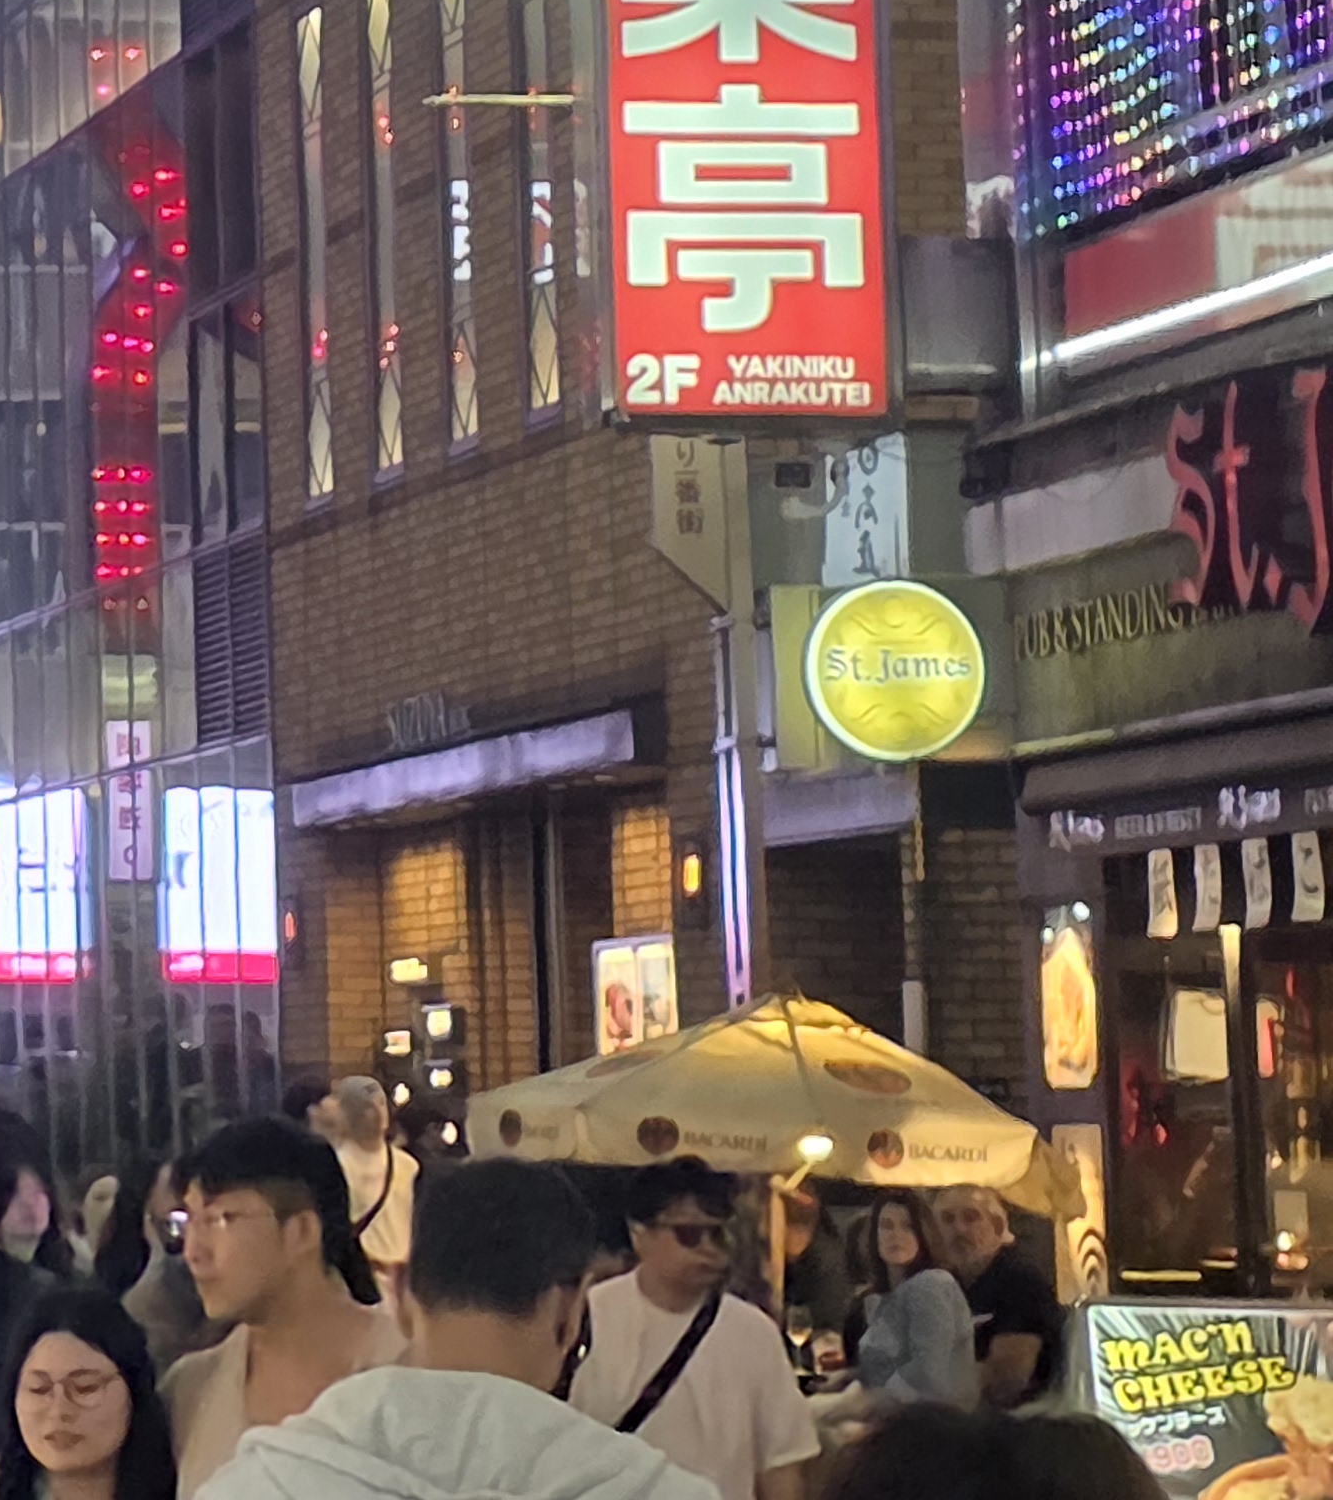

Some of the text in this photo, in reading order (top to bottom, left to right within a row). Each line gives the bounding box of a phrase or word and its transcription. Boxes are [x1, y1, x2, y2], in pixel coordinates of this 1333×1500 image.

[626, 355, 700, 406] 2F
[727, 356, 855, 379] YAKINIKU
[712, 380, 871, 407] ANRAKUTEI
[1113, 1357, 1296, 1413] CHEESE
